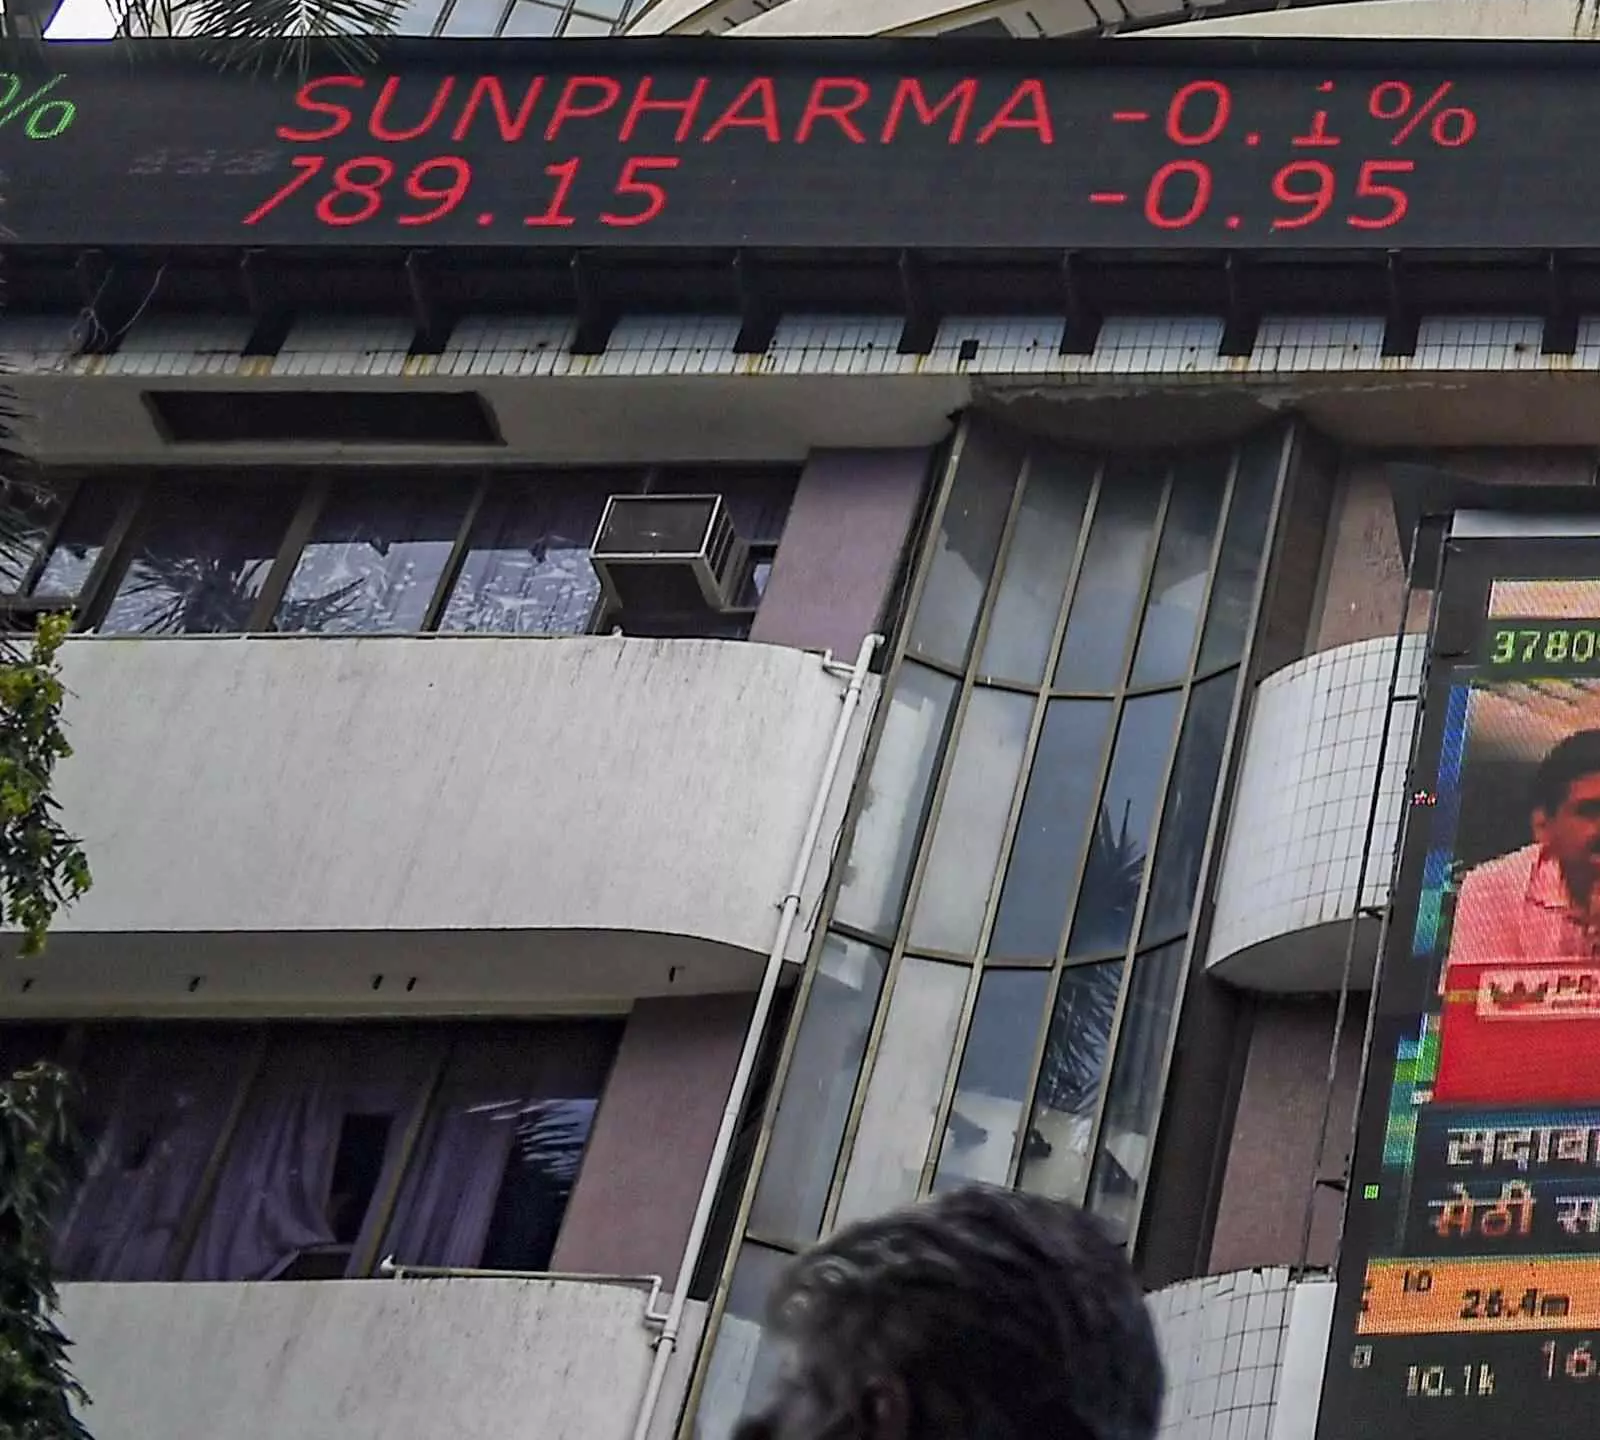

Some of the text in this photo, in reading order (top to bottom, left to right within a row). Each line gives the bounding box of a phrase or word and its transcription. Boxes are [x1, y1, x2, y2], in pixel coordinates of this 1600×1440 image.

[274, 74, 1057, 147] SUNPHARMA
[240, 154, 1415, 230] 789.15 -0.95
